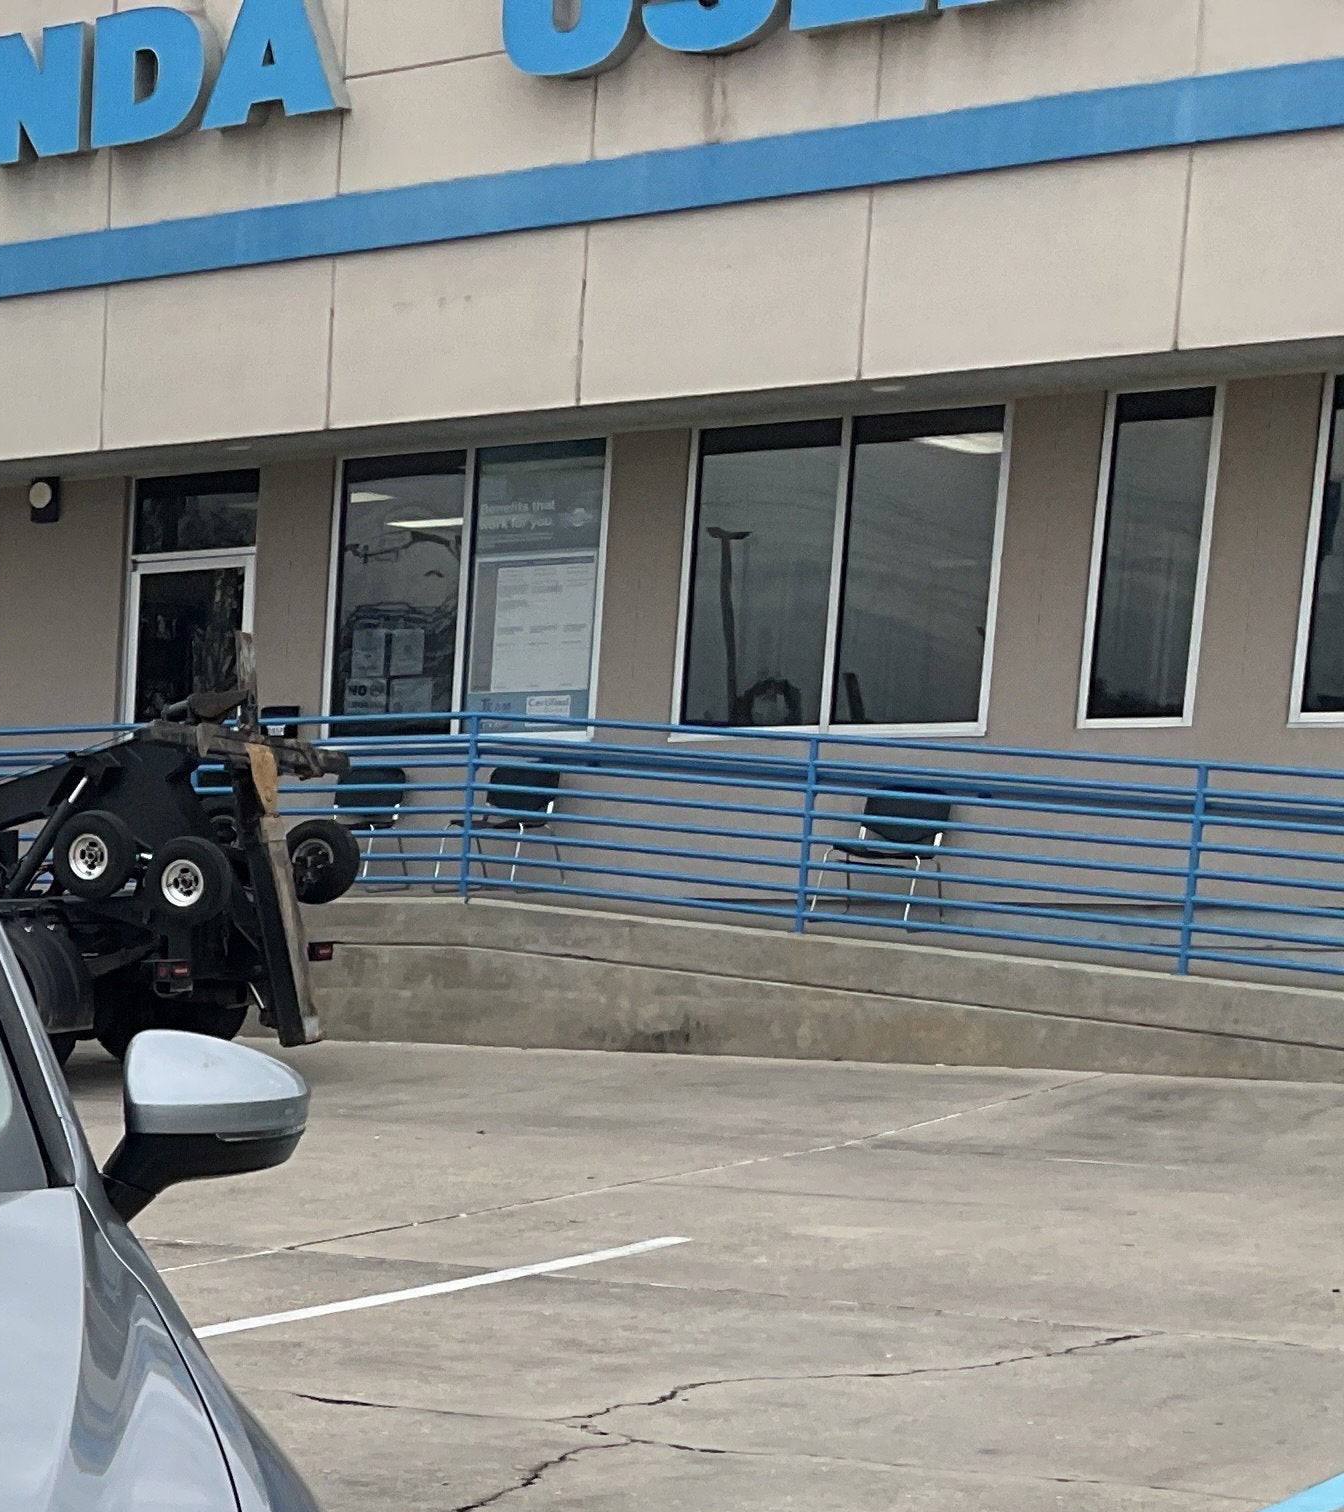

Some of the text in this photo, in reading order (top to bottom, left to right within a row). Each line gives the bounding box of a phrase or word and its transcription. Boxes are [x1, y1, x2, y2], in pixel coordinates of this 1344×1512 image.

[480, 500, 555, 514] Benefits that
[531, 517, 552, 530] you
